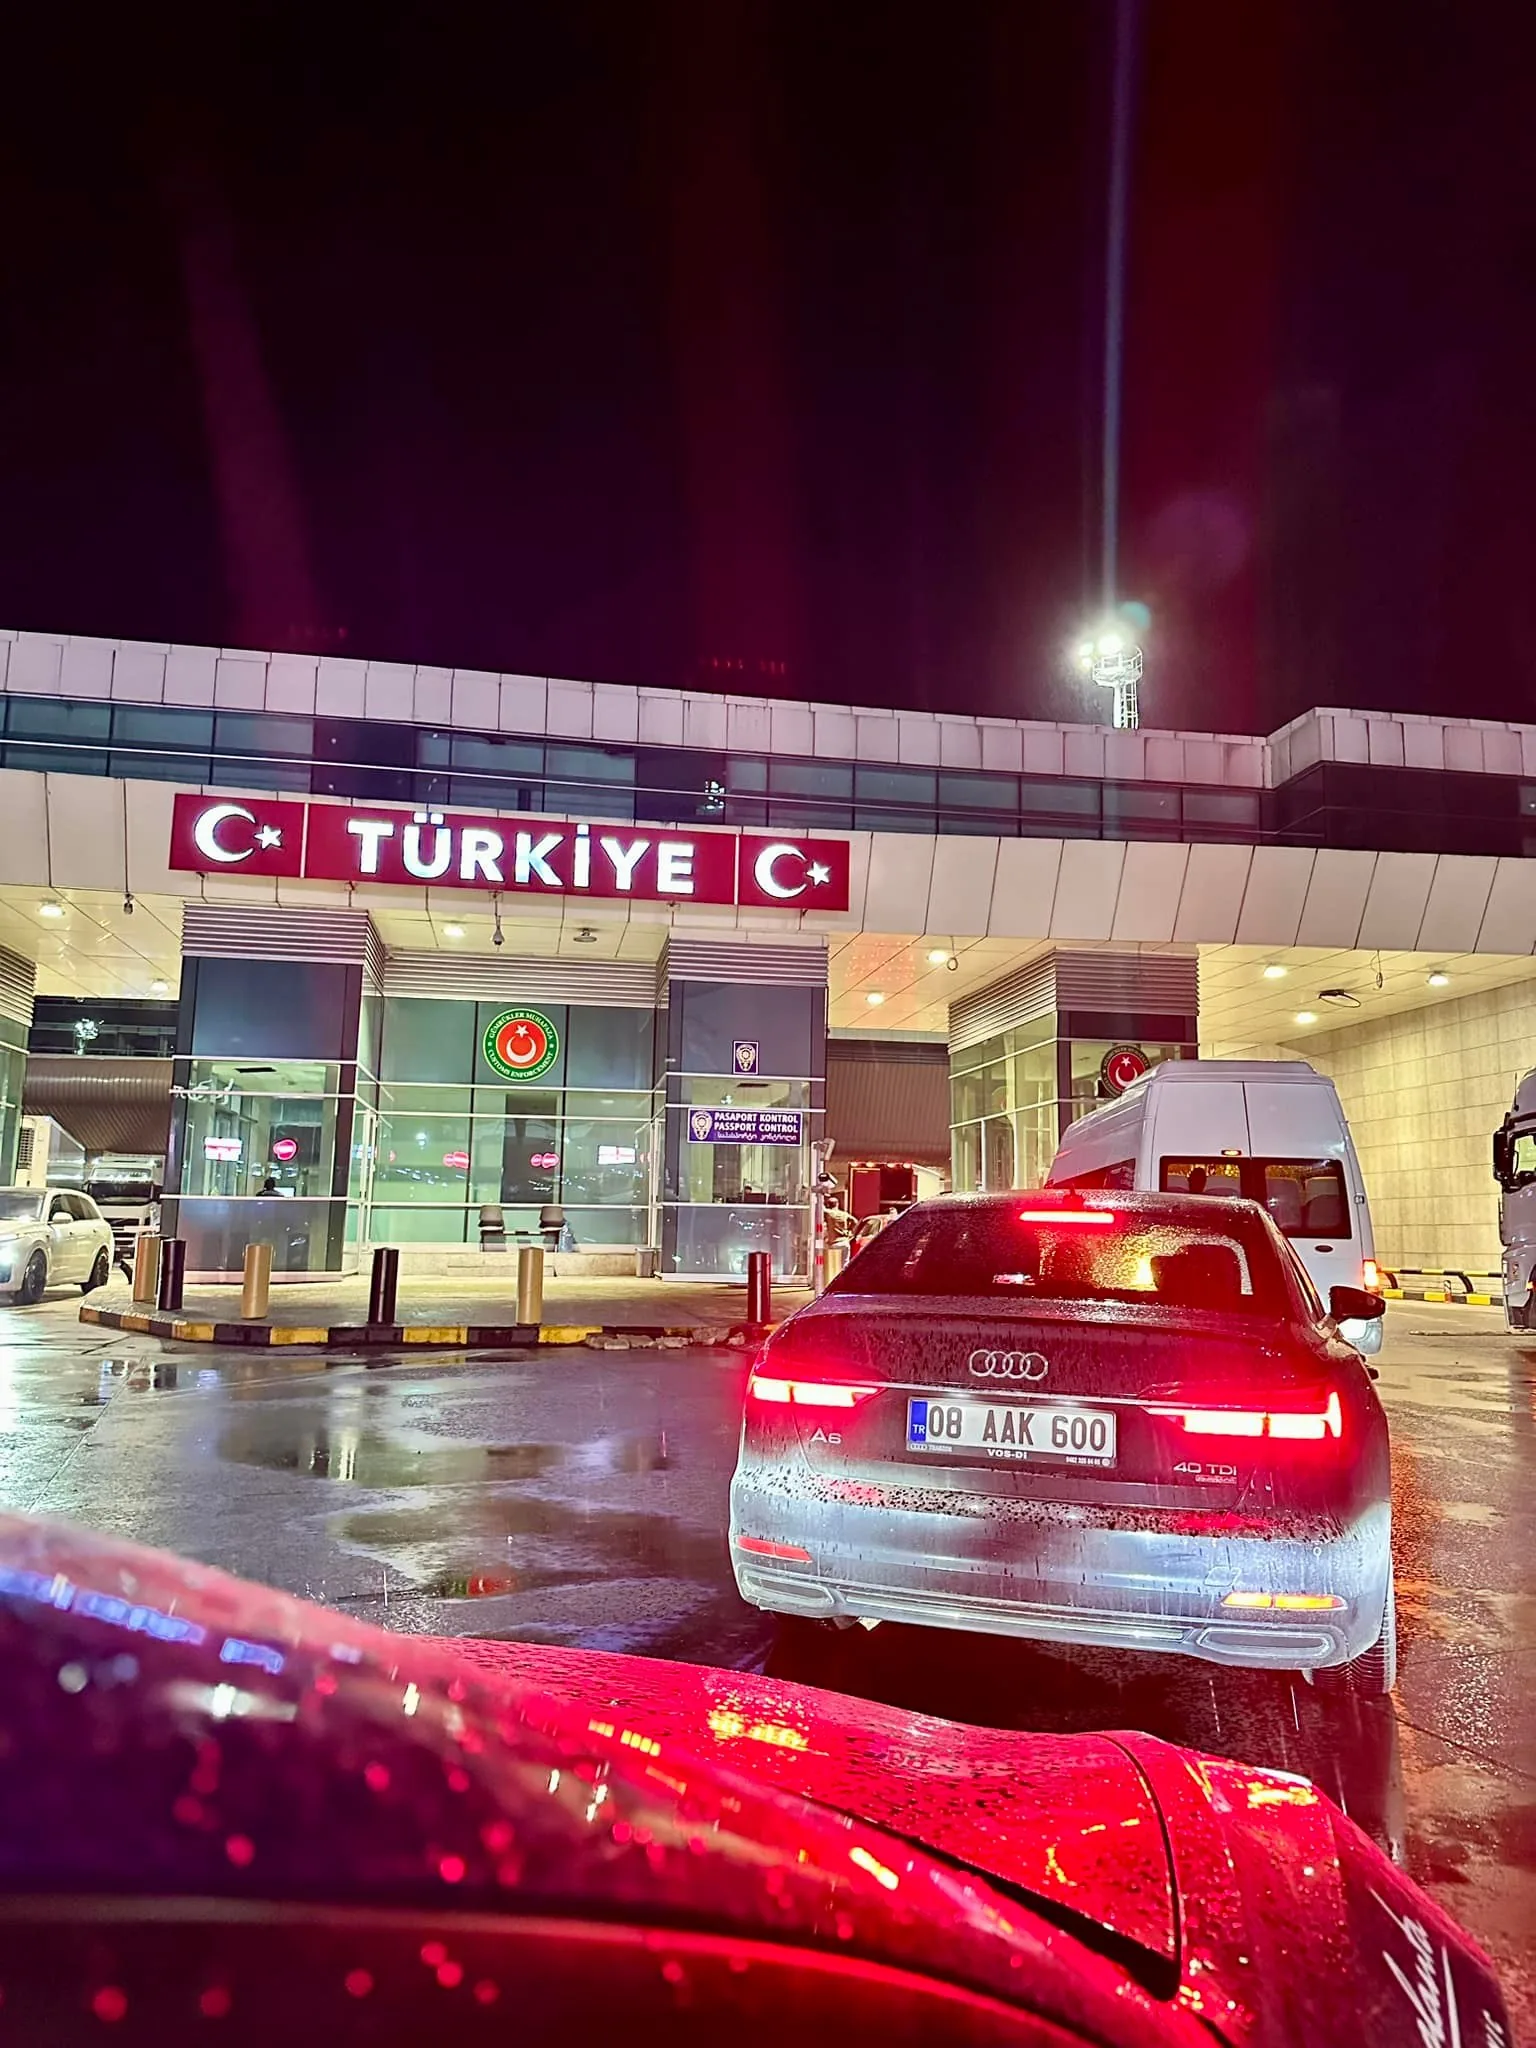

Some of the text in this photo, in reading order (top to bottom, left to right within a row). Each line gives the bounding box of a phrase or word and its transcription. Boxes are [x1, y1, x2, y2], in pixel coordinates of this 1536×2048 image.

[347, 811, 695, 894] TÜRKİYE
[714, 1112, 799, 1124] PASAPORT KONTROL
[713, 1122, 799, 1133] PASSPORT CONTROL
[912, 1424, 926, 1435] TR
[929, 1405, 1106, 1451] 08 AAK 600
[1173, 1462, 1237, 1476] 40 TDI
